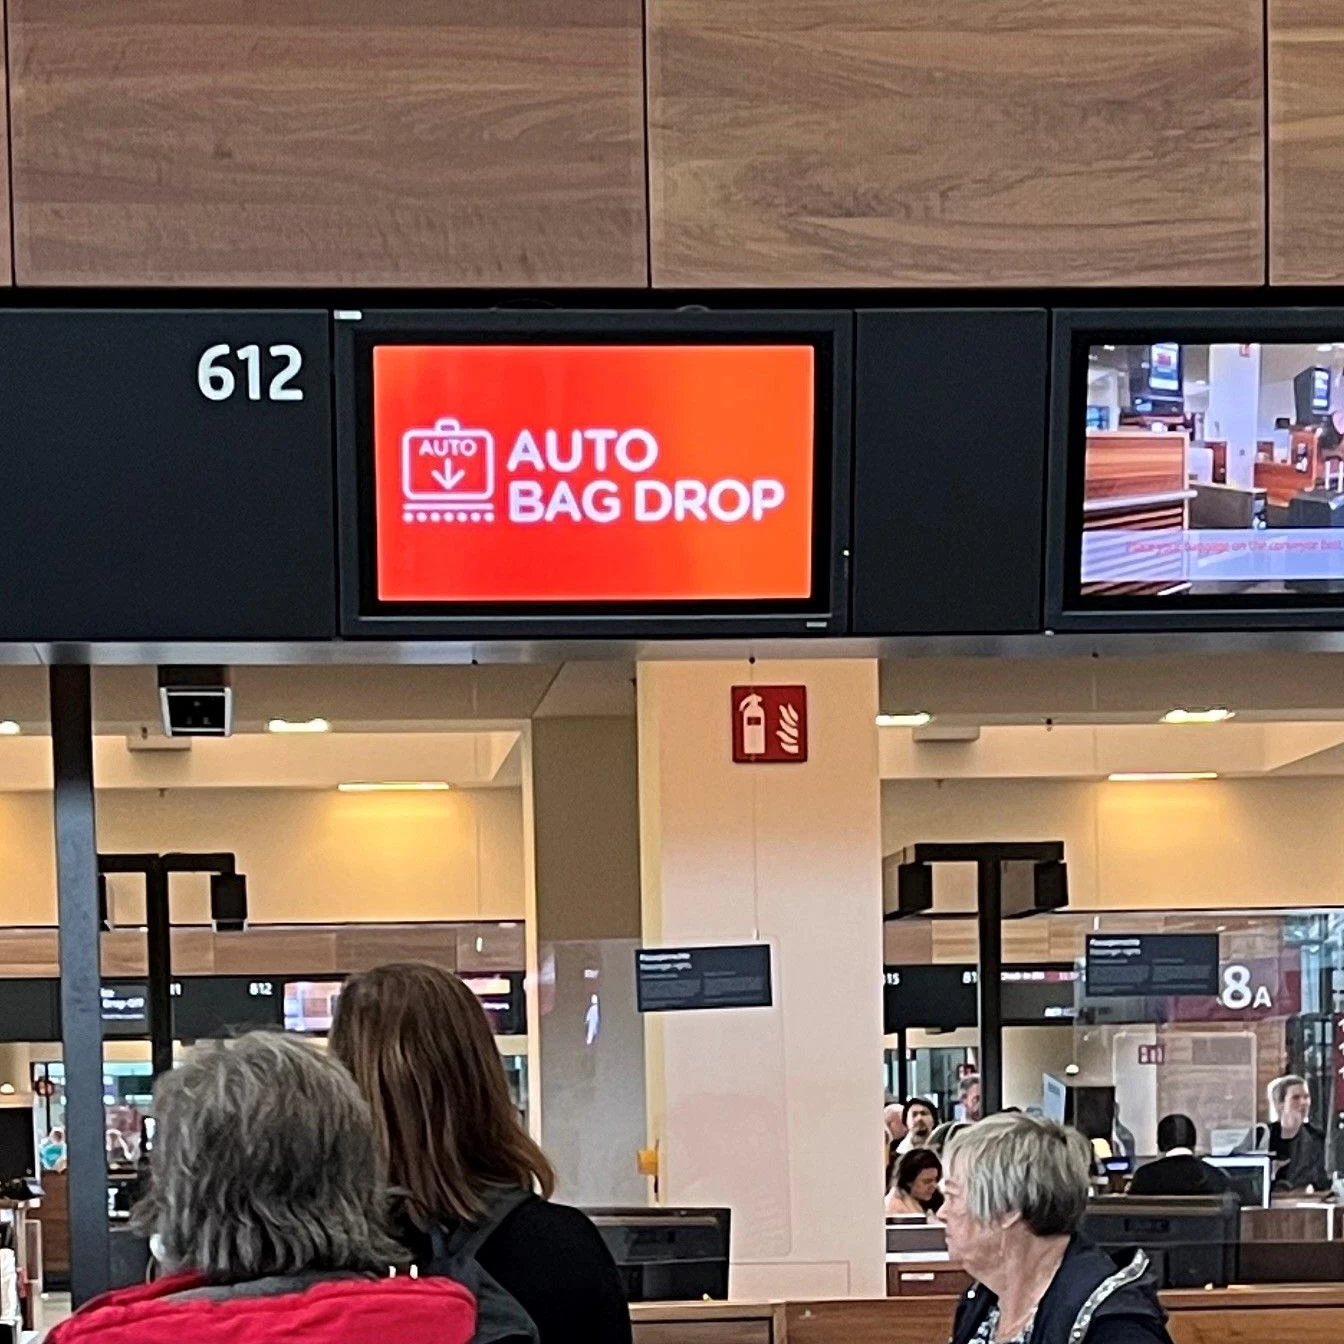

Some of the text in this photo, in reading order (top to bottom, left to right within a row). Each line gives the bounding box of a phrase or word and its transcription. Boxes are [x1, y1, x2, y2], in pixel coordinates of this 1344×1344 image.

[197, 343, 304, 401] 612
[418, 438, 478, 457] AUTO
[506, 427, 660, 473] AUTO
[508, 478, 786, 524] BAG DROP
[1221, 963, 1273, 1010] 8A
